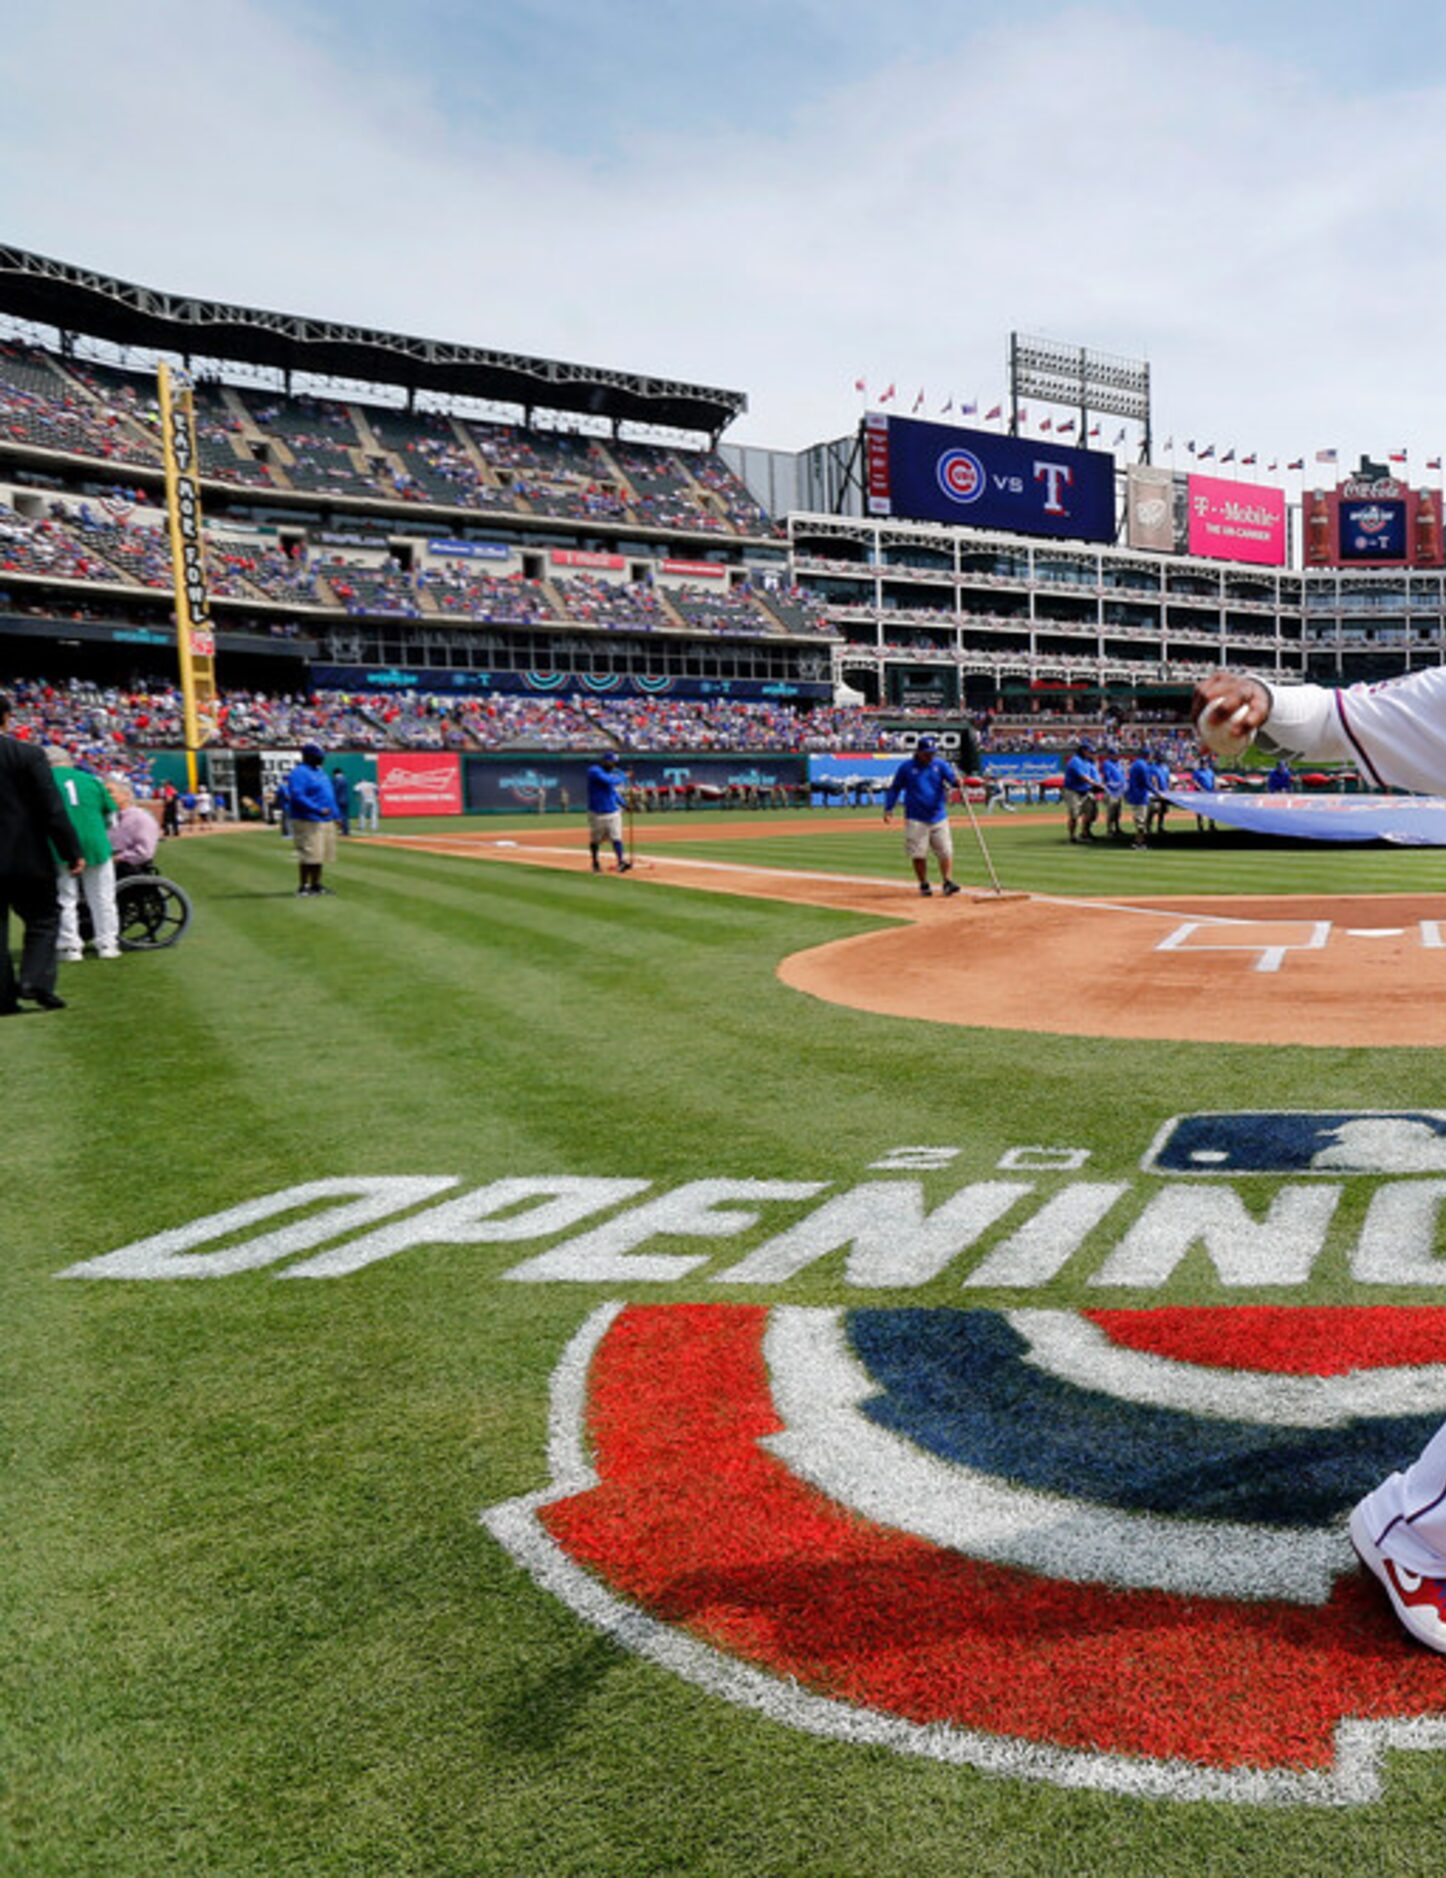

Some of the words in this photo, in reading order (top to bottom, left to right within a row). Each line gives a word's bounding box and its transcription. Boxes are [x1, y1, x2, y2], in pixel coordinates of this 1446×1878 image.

[171, 410, 190, 470] EAT
[176, 477, 198, 541] MOR
[993, 474, 1023, 493] VS
[1033, 459, 1074, 518] T
[182, 544, 206, 624] FOWL
[64, 779, 79, 806] 1
